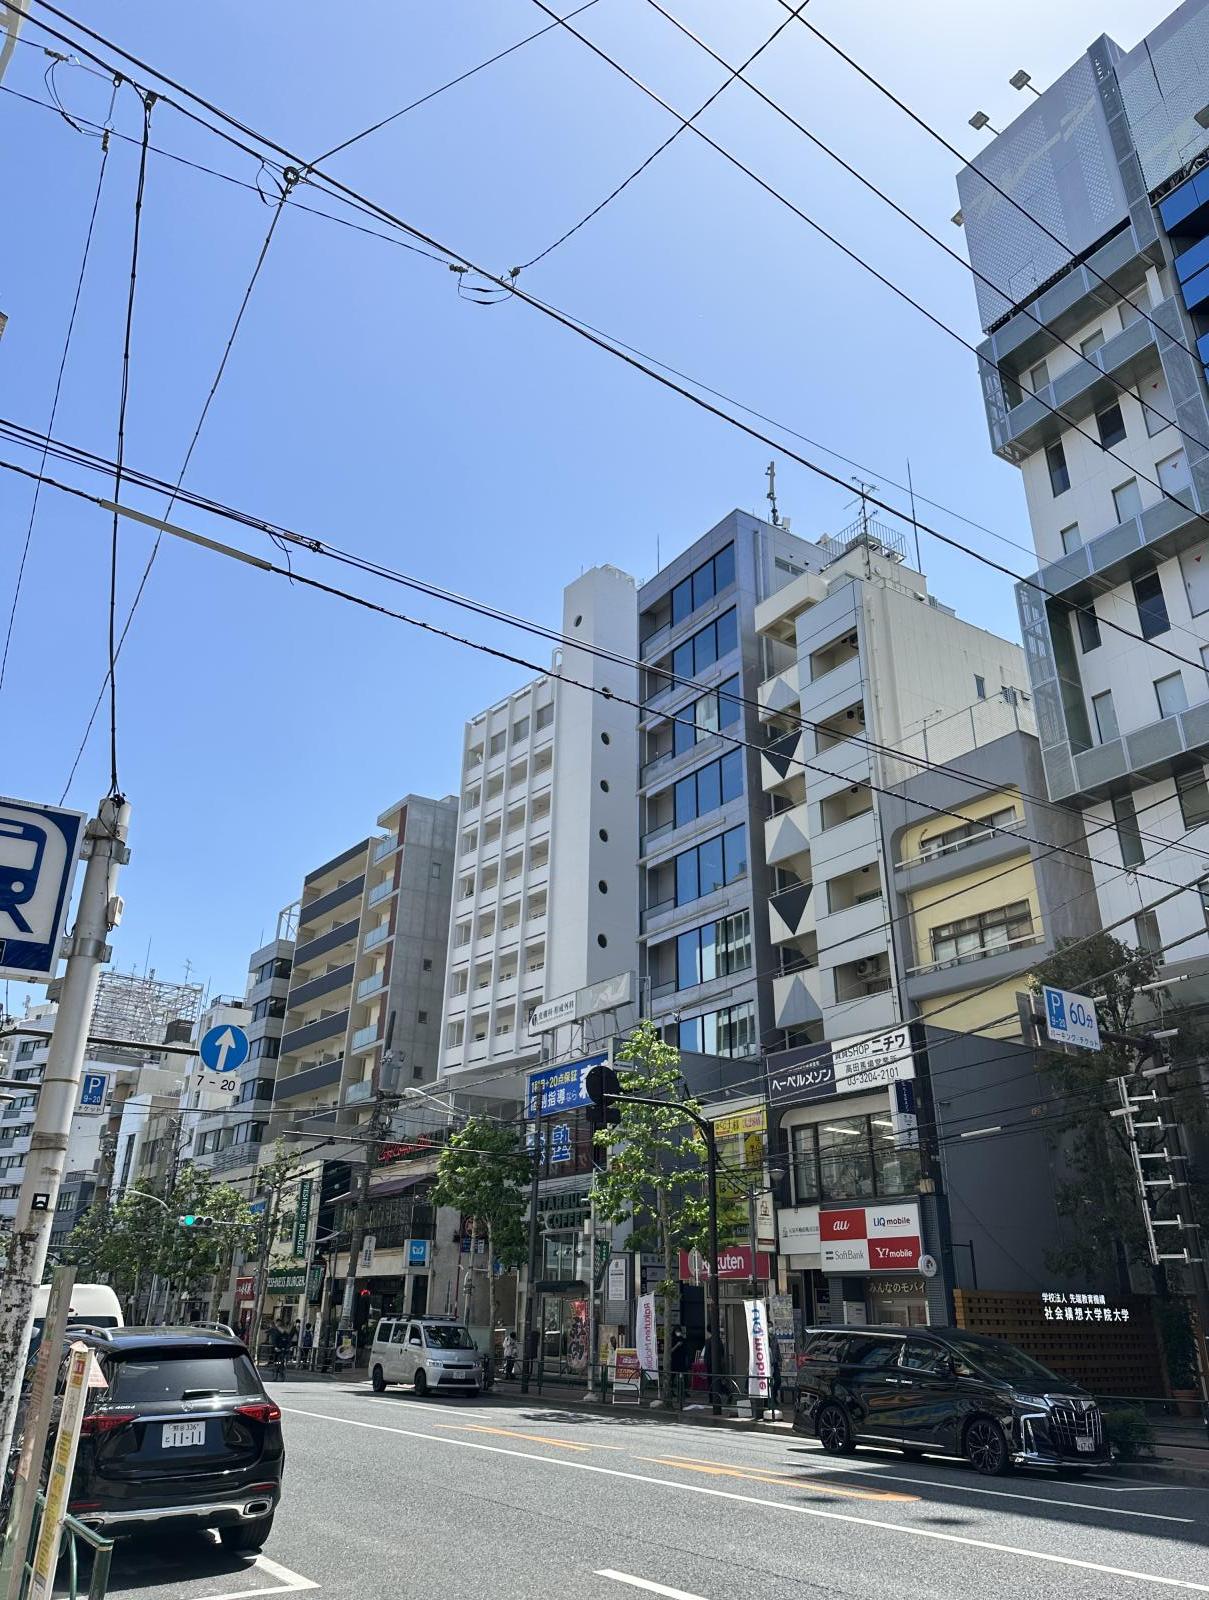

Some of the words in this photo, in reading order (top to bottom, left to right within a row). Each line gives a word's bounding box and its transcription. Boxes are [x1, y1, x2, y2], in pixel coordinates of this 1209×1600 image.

[1069, 1002, 1093, 1029] 60分
[871, 1033, 906, 1053] ニチワ
[847, 1066, 900, 1087] 03-3204-2101
[88, 1077, 101, 1094] P
[832, 1219, 850, 1232] au
[873, 1217, 886, 1228] UQ
[886, 1216, 911, 1226] mobile
[296, 1223, 306, 1255] BURGER
[834, 1250, 864, 1261] SoftBank
[1041, 1292, 1068, 1304] 学校法人
[1044, 1306, 1130, 1322] 社会構想大学院大学
